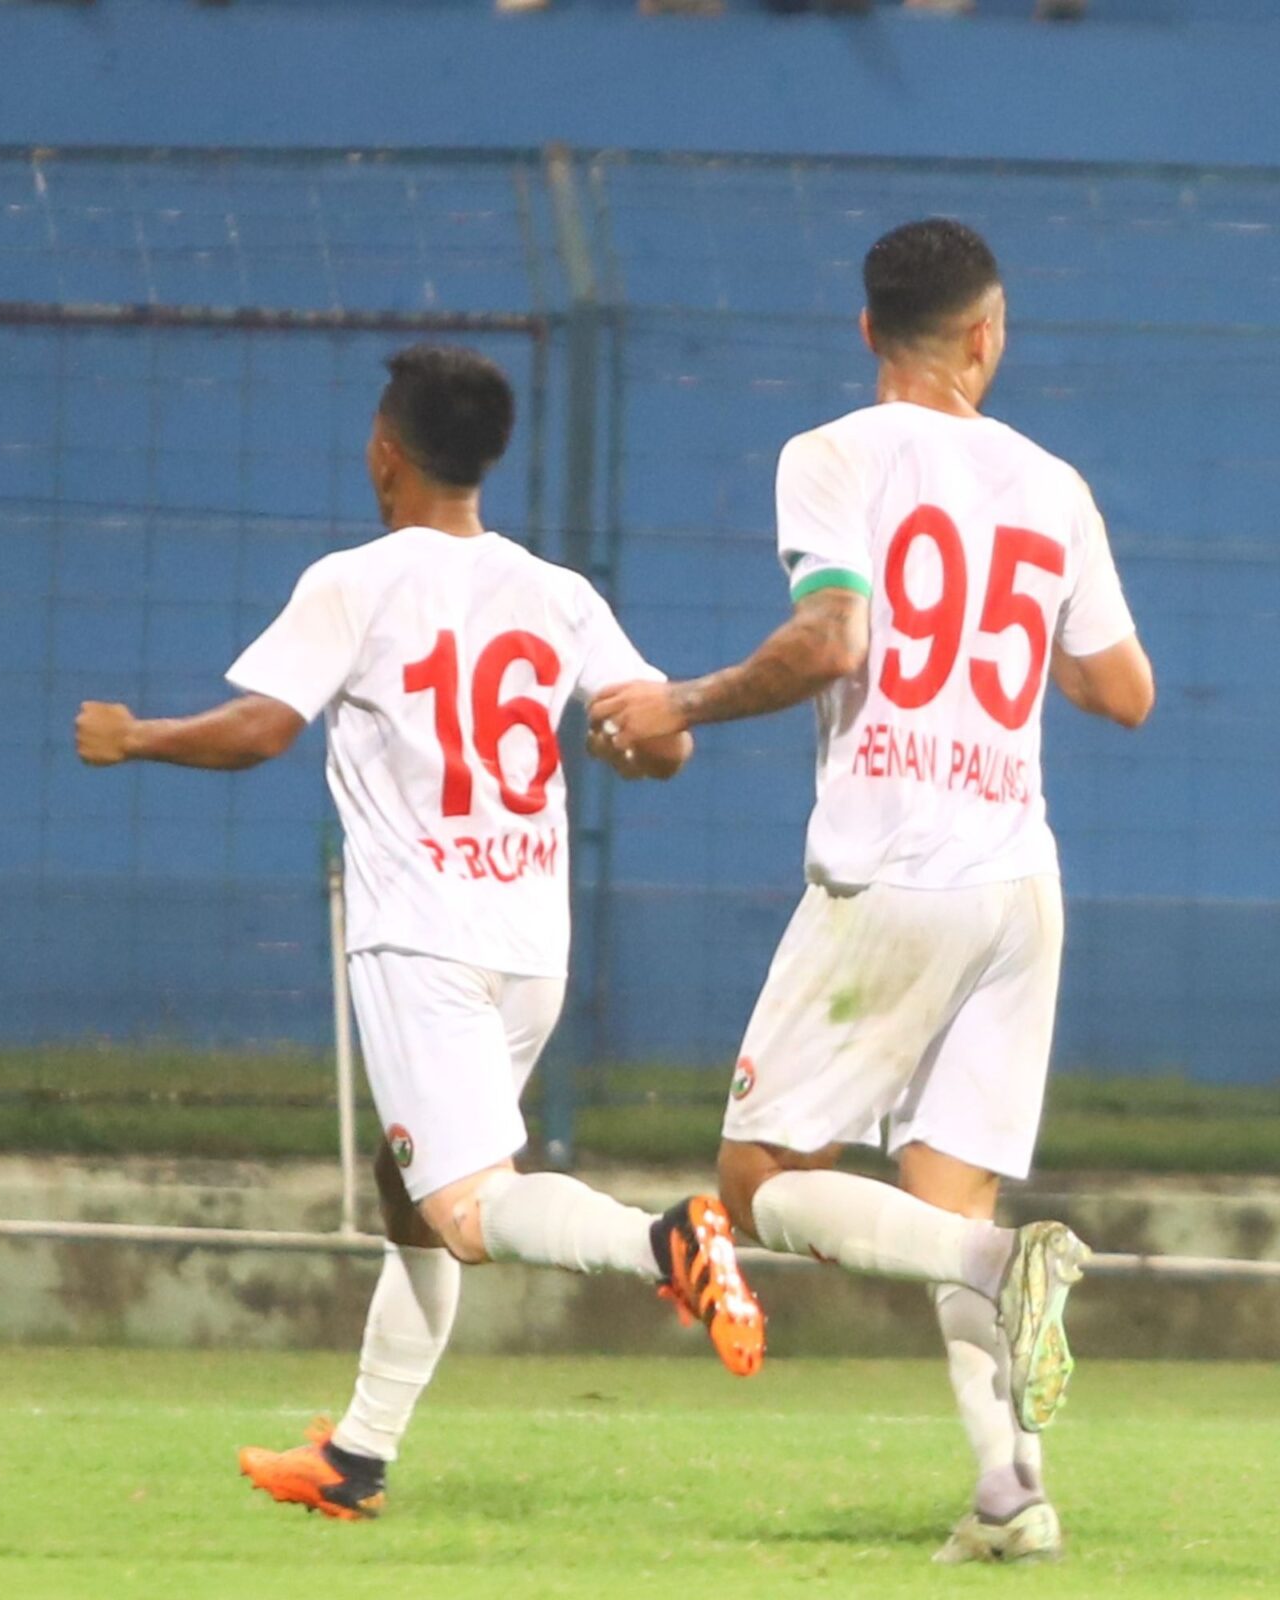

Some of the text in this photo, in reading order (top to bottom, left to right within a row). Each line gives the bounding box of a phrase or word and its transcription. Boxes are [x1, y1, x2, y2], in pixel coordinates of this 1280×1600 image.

[878, 503, 1066, 731] 95
[403, 629, 561, 817] 16
[852, 723, 937, 783] RENAN
